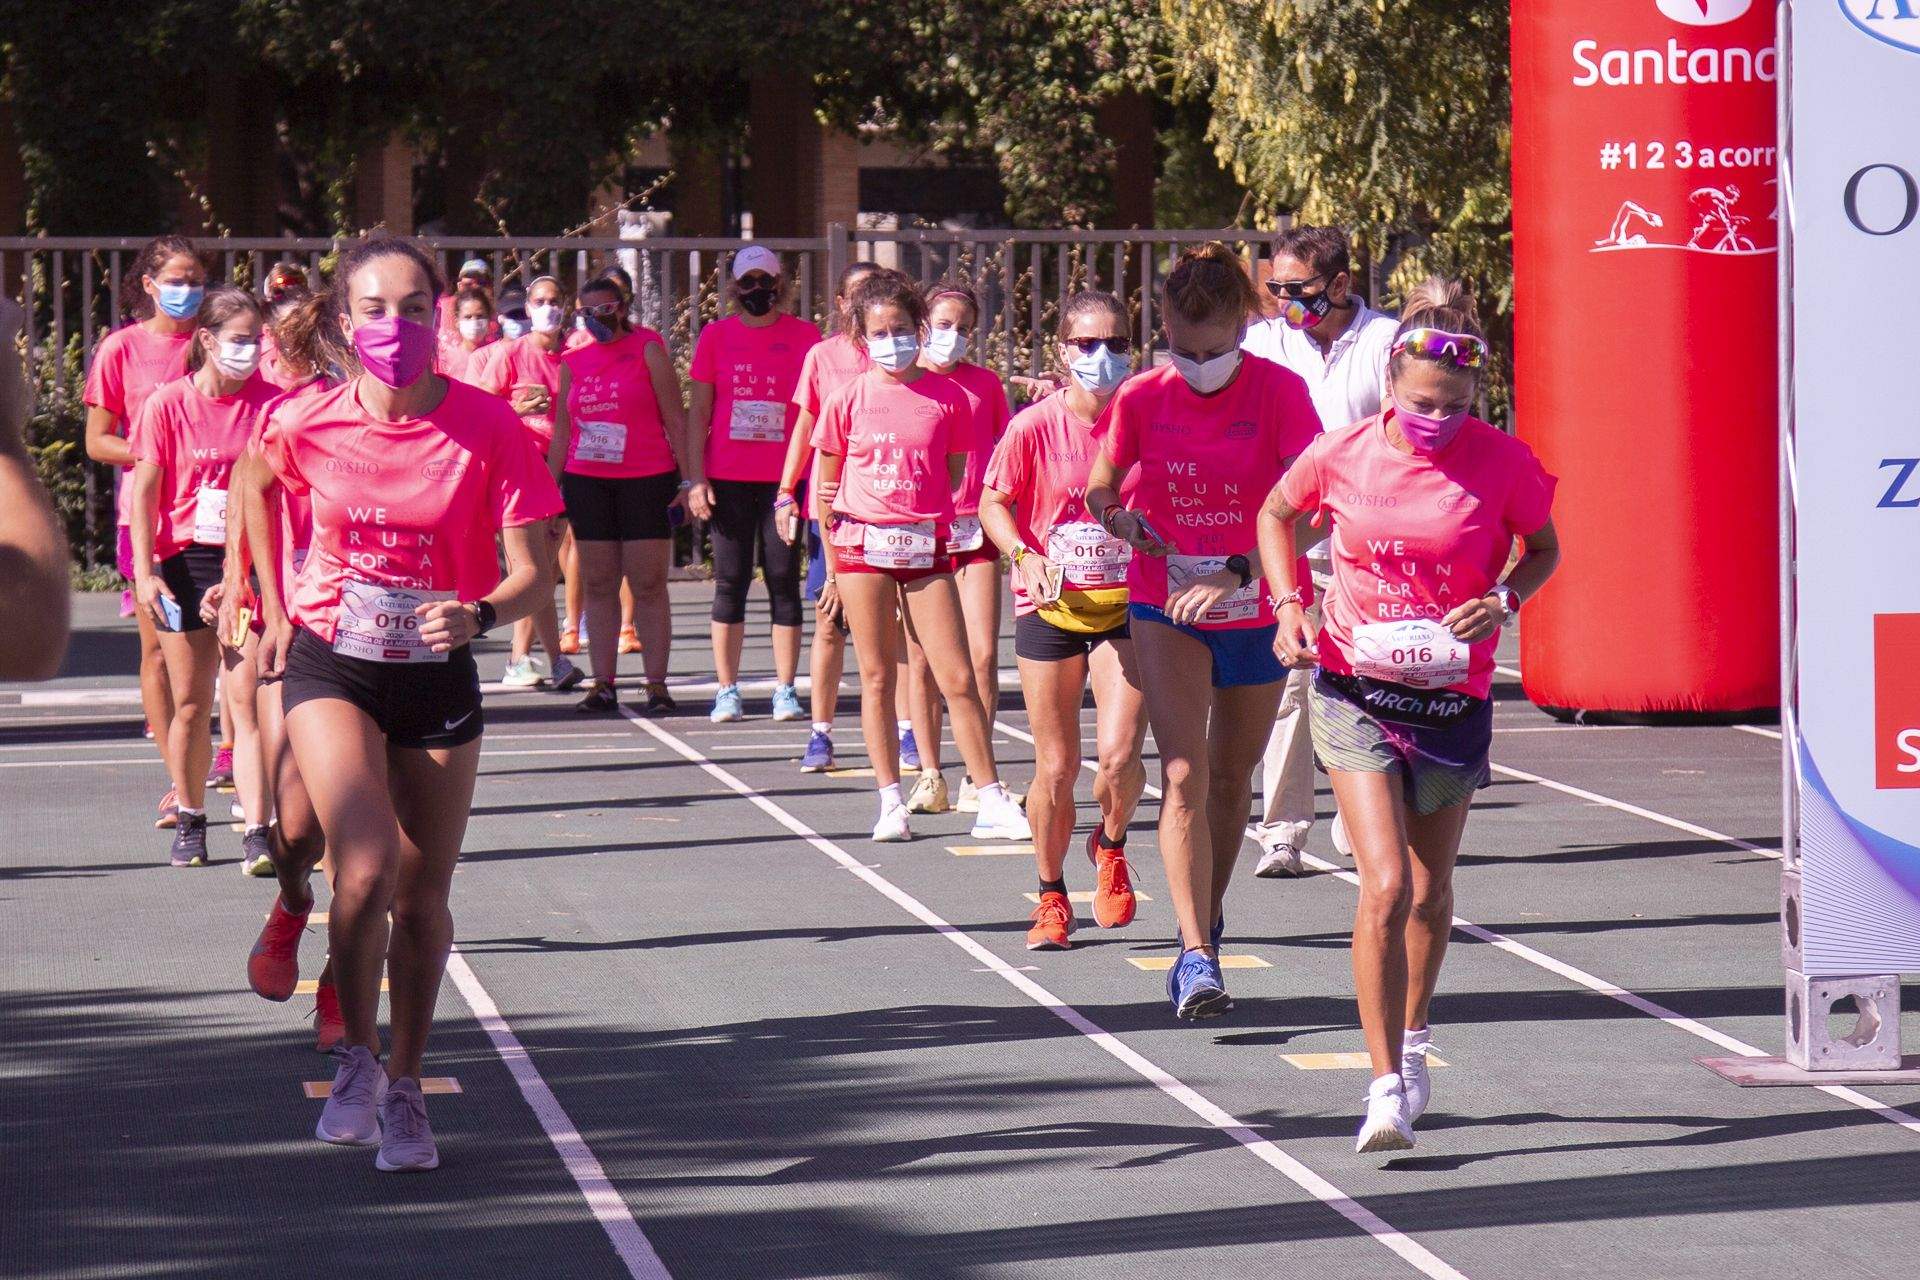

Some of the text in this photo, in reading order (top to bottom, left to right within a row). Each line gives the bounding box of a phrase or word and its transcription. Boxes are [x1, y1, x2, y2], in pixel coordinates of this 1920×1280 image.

[733, 386, 753, 396] FOR
[748, 414, 769, 424] 016
[872, 432, 896, 443] WE
[191, 447, 219, 460] WE
[325, 459, 379, 475] OYSHO
[873, 463, 898, 475] FOR
[1166, 461, 1197, 476] WE
[873, 479, 921, 490] REASON
[347, 506, 387, 525] WE
[1175, 510, 1243, 527] REASON
[887, 534, 913, 546] 016
[1075, 544, 1106, 558] 016
[1366, 539, 1405, 556] WE
[349, 552, 433, 570] FOR A
[1437, 582, 1451, 596] A
[375, 613, 418, 630] 016
[342, 630, 373, 644] CARRERA
[1391, 646, 1433, 665] 016
